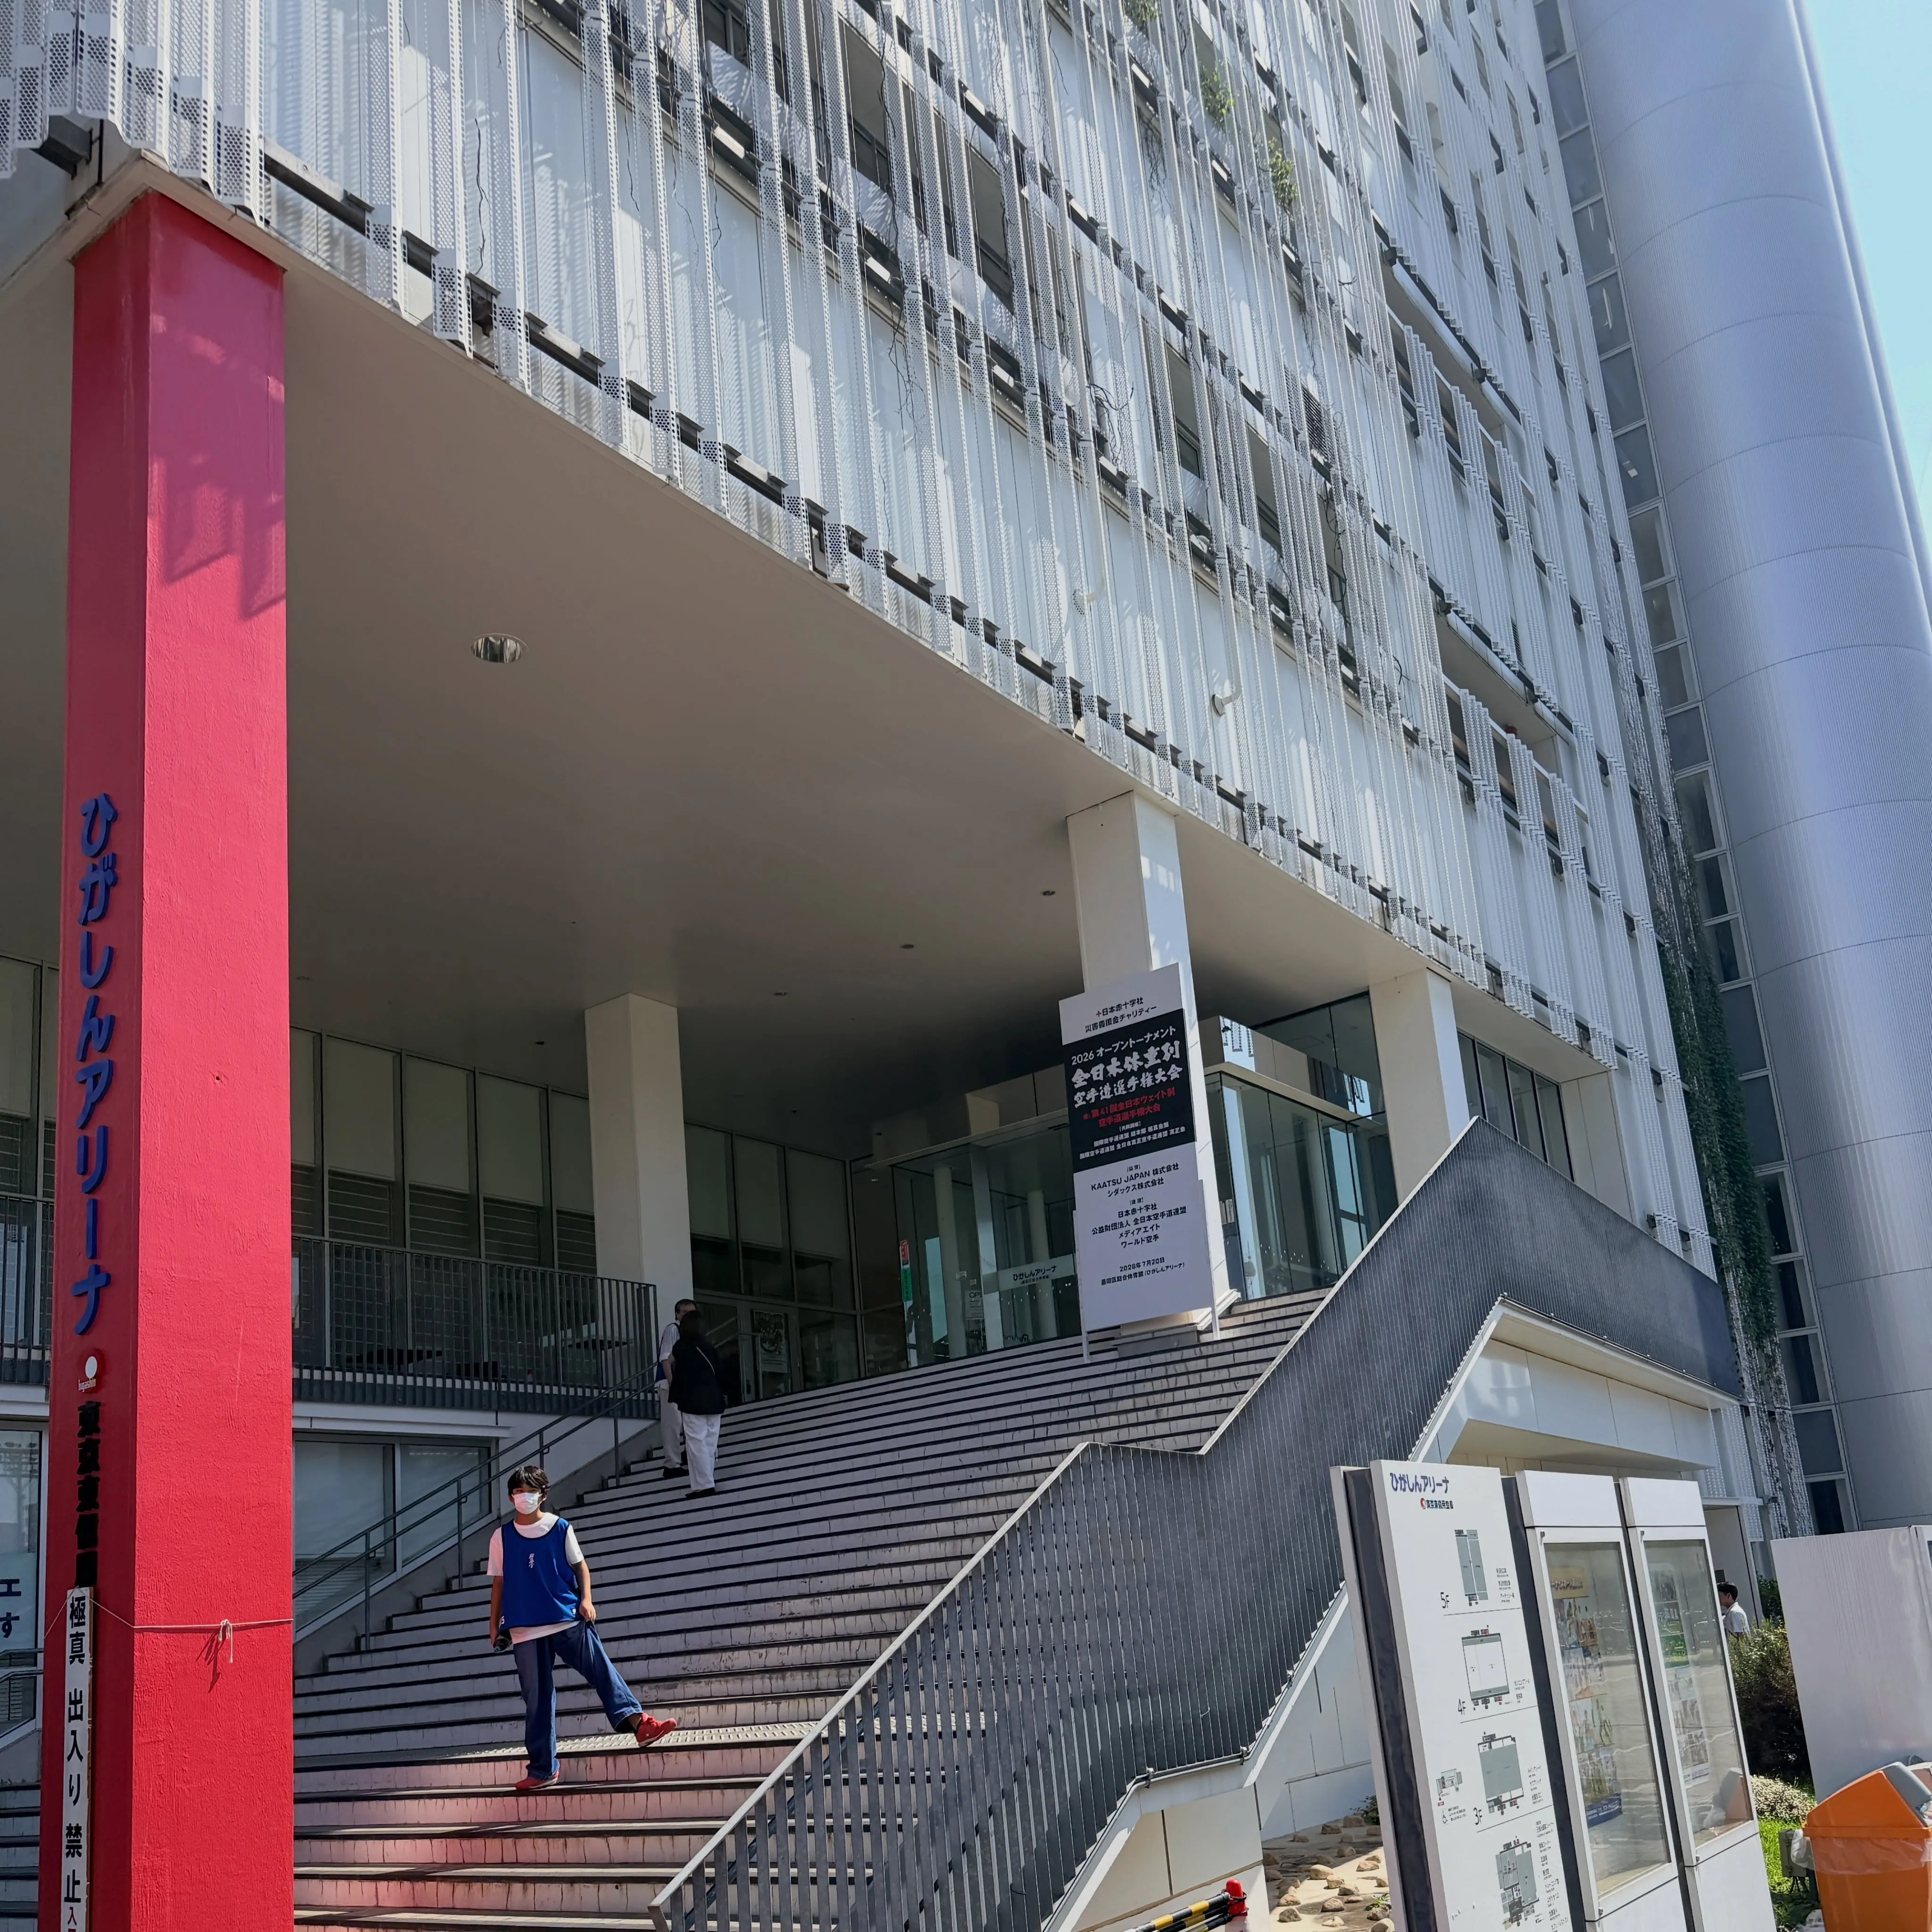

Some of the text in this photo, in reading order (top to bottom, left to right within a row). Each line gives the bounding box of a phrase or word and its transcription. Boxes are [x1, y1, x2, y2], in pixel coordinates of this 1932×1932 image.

[1071, 1025, 1176, 1066] 2026 オープントーナメント
[71, 792, 118, 1336] ひがしんアリーナ
[1071, 1040, 1180, 1089] 全日本体重別
[1074, 1064, 1183, 1108] 空手道選手権大会
[1091, 1163, 1179, 1191] KAATSU JAPAN 株式会社
[1108, 1177, 1164, 1197] シダックス株式会社
[1119, 1223, 1160, 1239] メディアエイト
[1121, 1234, 1159, 1249] ワールド空手
[1013, 1265, 1057, 1281] ひがしんアリーナ
[1390, 1472, 1449, 1494] ひがしんアリーナ
[1440, 1592, 1449, 1609] 5F
[1457, 1699, 1466, 1715] 4F
[1473, 1807, 1482, 1825] 3F
